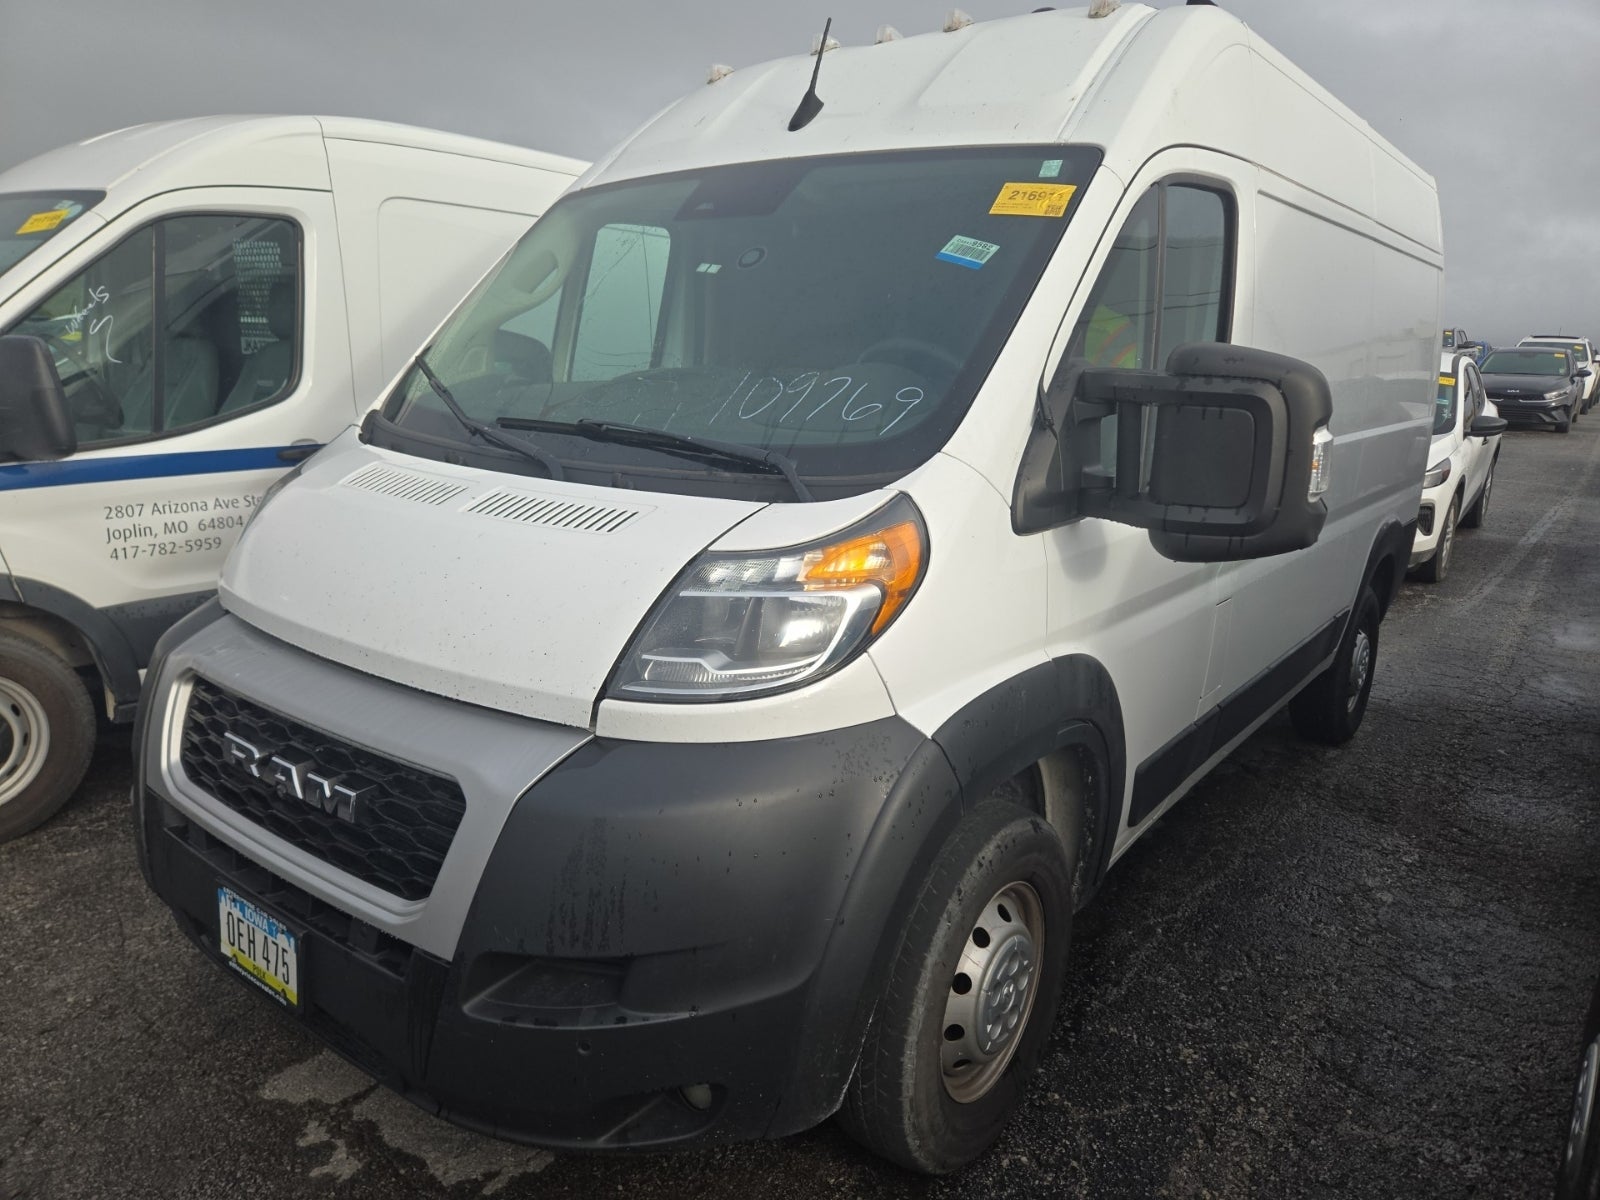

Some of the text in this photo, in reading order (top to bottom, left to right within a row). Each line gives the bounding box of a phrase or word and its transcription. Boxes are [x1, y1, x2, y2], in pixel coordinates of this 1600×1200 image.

[104, 503, 145, 520] 2807
[151, 500, 209, 516] Arizona
[213, 496, 240, 510] Ave
[106, 515, 245, 544] Joplin, MO 64804
[110, 536, 223, 561] 417-782-5959
[223, 731, 357, 824] RAM
[243, 907, 270, 932] IOWA
[261, 934, 290, 985] 475
